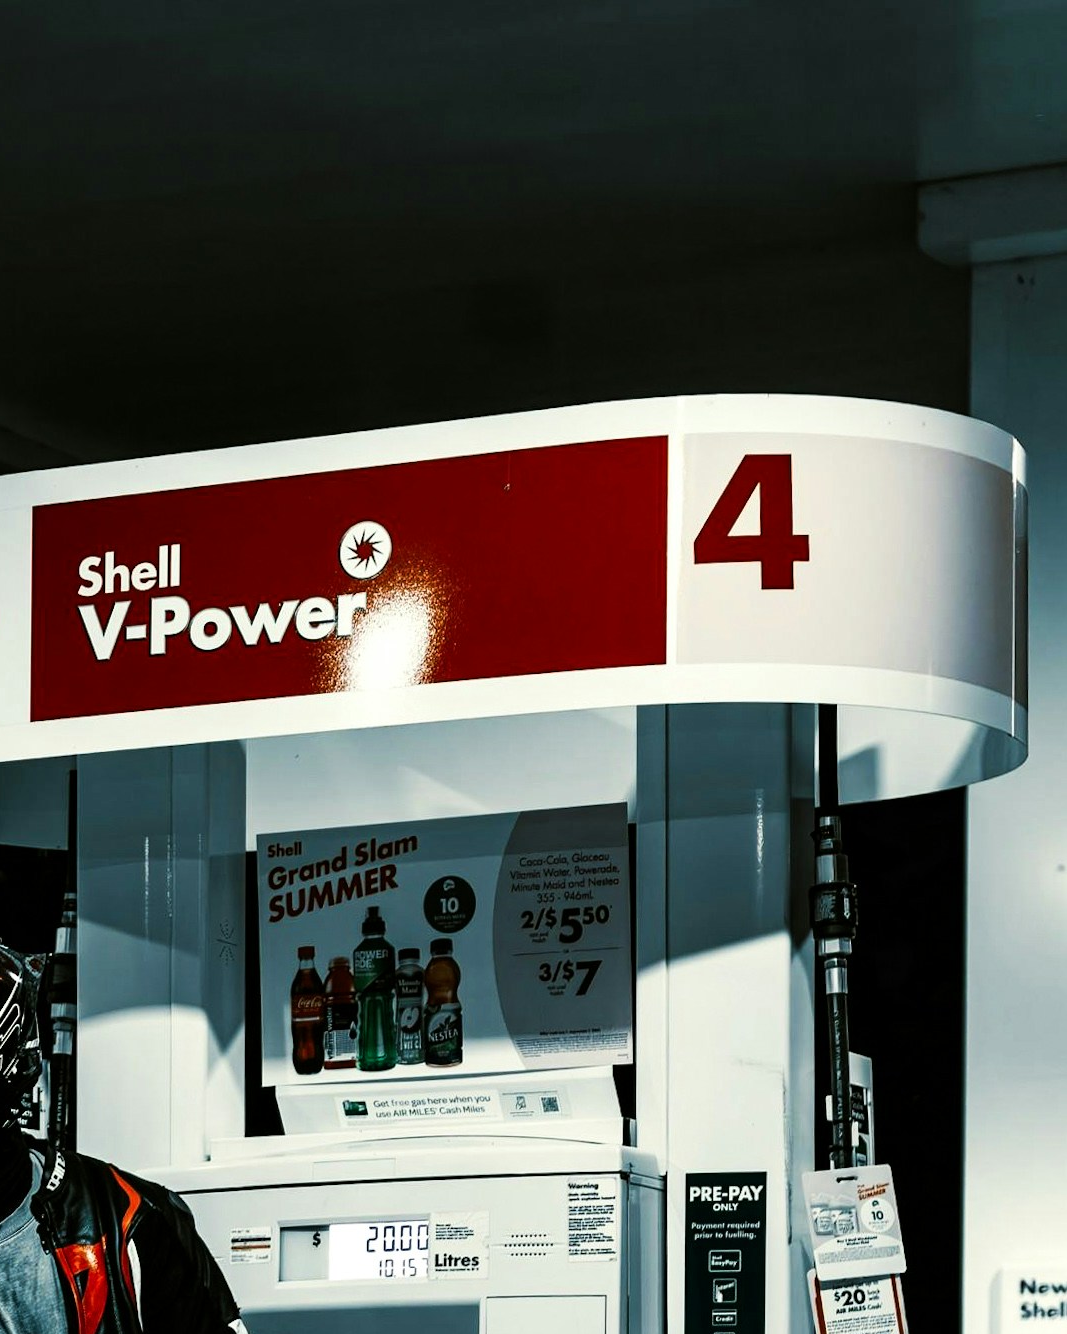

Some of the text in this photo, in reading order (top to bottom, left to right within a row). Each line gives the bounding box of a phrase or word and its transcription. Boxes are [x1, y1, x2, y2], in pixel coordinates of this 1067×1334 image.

[694, 454, 809, 590] 4
[78, 543, 181, 598] Shell
[78, 591, 367, 660] V-Power
[267, 842, 302, 858] Shell
[268, 835, 418, 890] Grand Slam
[510, 869, 541, 880] Vitamin
[511, 877, 619, 892] Minute Maid and Nestea
[268, 864, 399, 924] SUMMER
[537, 893, 555, 904] 355
[440, 897, 459, 914] 10
[429, 1030, 459, 1042] NESTEA
[373, 1096, 491, 1108] Get free gas here when you
[393, 1109, 408, 1117] AIR
[439, 1106, 460, 1115] Cash
[463, 1105, 485, 1114] Miles
[689, 1185, 764, 1202] PRE-PAY
[713, 1203, 739, 1212] ONLY
[871, 1210, 884, 1221] 10
[691, 1221, 761, 1232] Payment required
[312, 1231, 321, 1248] $
[366, 1225, 429, 1252] 20.00
[694, 1231, 714, 1240] prior
[715, 1231, 724, 1239] to
[434, 1253, 480, 1268] Litres
[1020, 1279, 1067, 1295] New
[834, 1288, 866, 1307] $20
